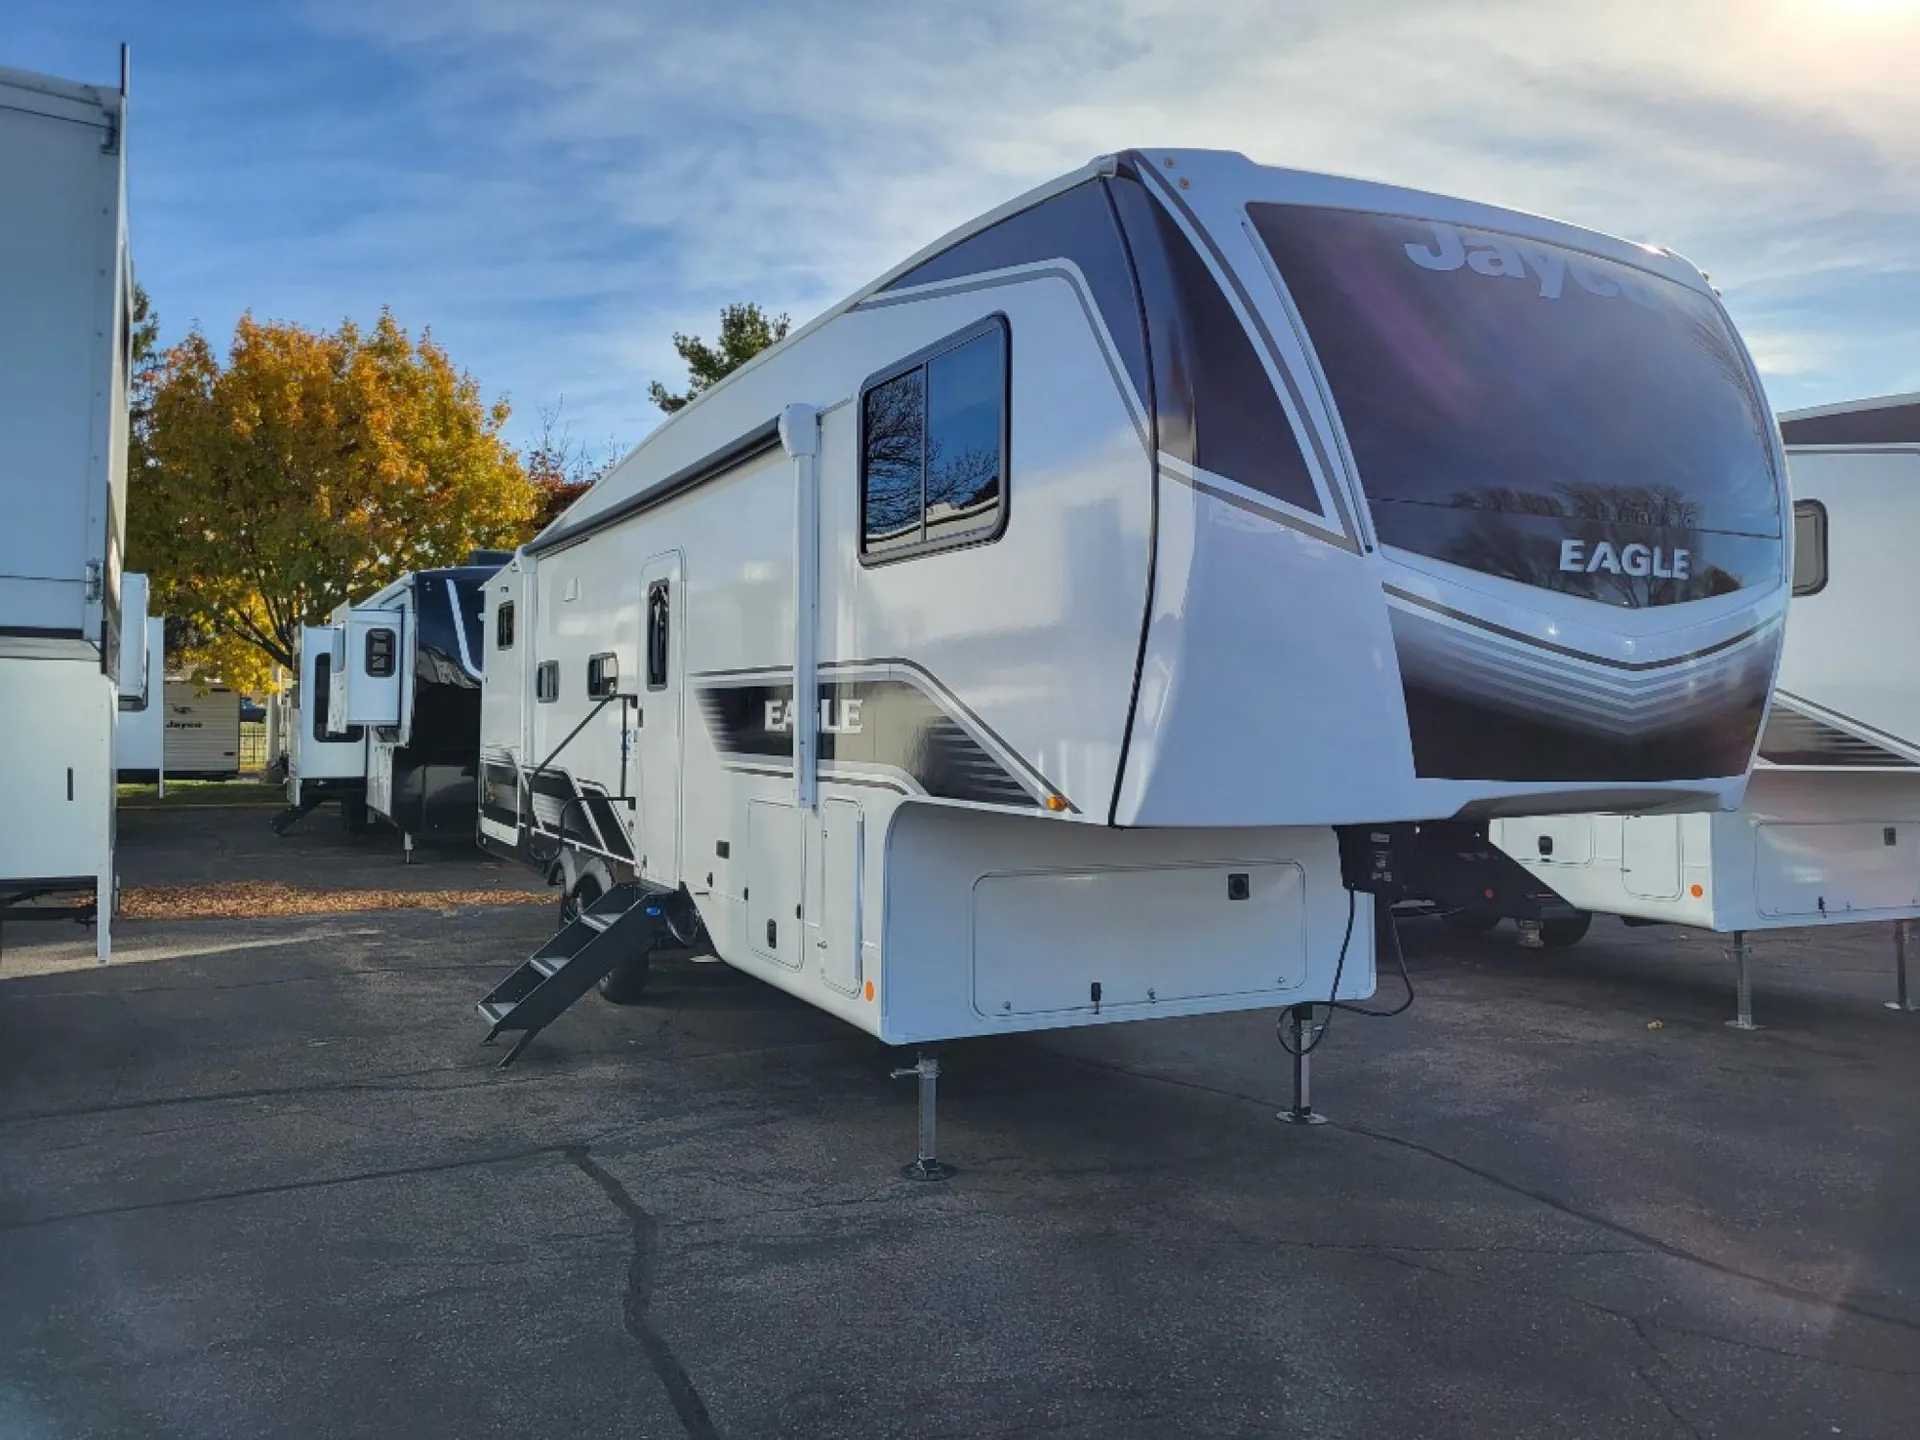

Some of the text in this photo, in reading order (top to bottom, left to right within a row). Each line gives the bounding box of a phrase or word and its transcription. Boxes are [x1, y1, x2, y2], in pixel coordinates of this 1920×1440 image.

[1403, 221, 1656, 307] Jayc
[1559, 539, 1691, 580] EAGLE
[764, 698, 864, 734] EALE
